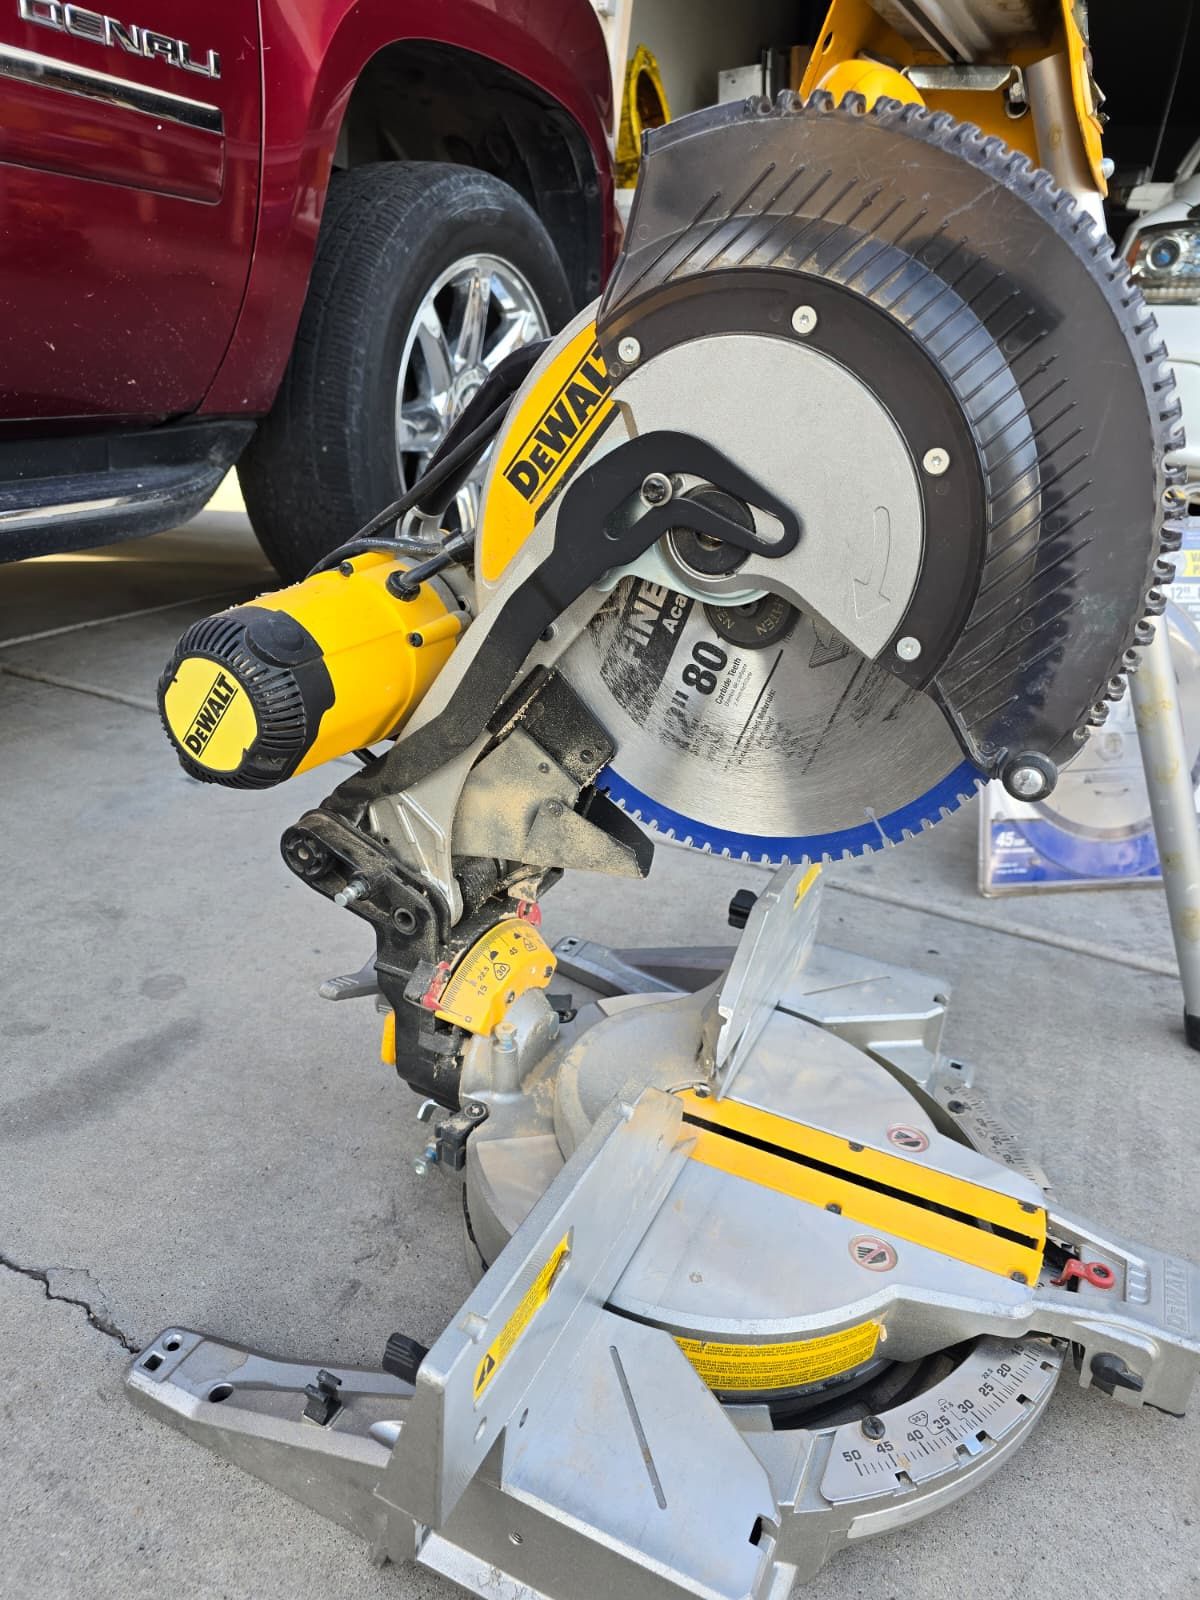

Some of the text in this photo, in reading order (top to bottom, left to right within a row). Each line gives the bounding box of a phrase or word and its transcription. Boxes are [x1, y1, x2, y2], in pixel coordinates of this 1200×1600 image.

[18, 0, 221, 79] DENALI
[682, 641, 728, 695] 80
[715, 678, 732, 705] Carbide
[727, 657, 742, 677] Teeth
[185, 674, 234, 756] DEWALT
[497, 965, 506, 976] 30
[478, 985, 488, 996] 15
[996, 1363, 1011, 1378] 20
[978, 1382, 994, 1397] 25
[957, 1399, 974, 1413] 30
[933, 1415, 951, 1430] 35
[907, 1429, 924, 1442] 40
[876, 1440, 894, 1454] 45
[842, 1449, 862, 1462] 50
